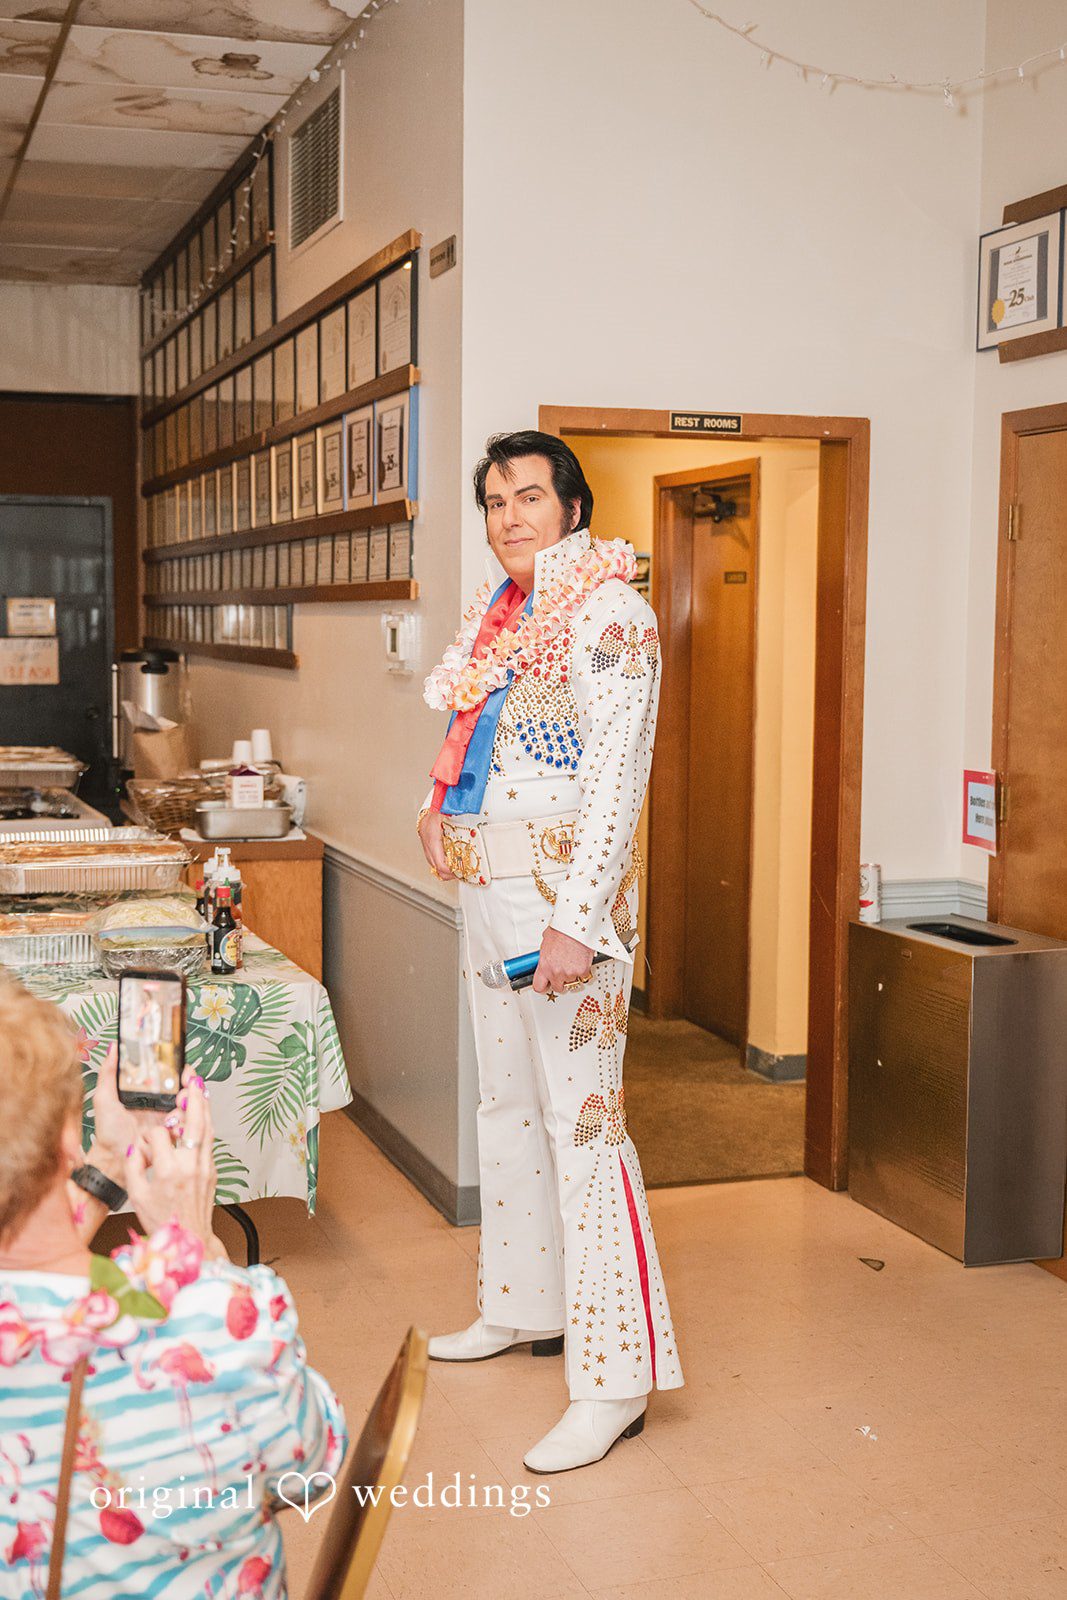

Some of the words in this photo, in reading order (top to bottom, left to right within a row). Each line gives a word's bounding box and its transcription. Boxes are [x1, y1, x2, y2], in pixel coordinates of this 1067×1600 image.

[1008, 287, 1025, 308] 25
[674, 417, 700, 428] REST
[703, 418, 738, 429] ROOMS
